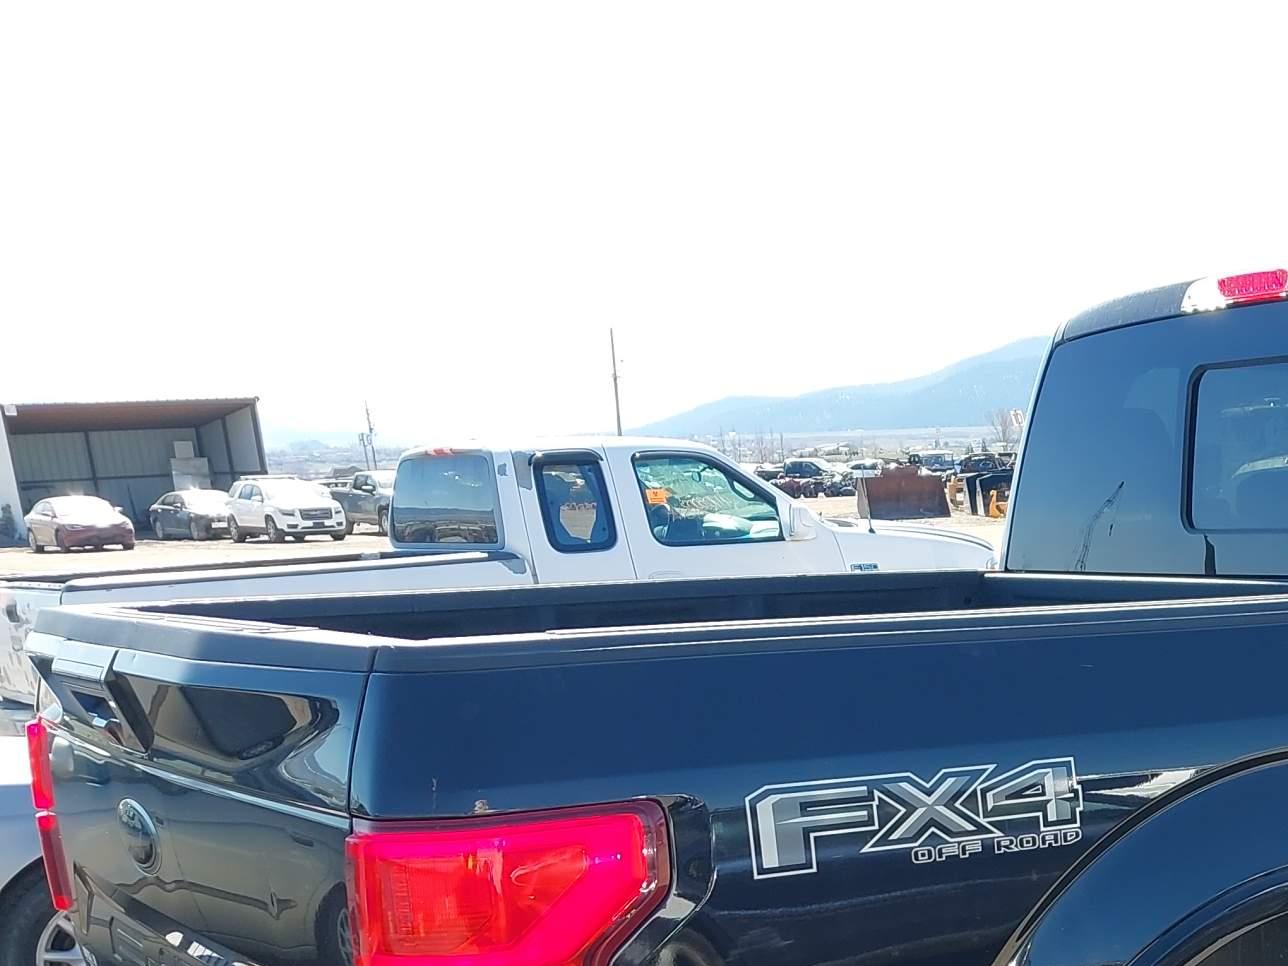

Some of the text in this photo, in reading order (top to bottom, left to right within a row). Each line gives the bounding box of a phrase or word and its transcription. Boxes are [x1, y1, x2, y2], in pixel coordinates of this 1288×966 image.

[745, 757, 1083, 879] FX4
[912, 829, 1083, 864] OFF ROAD
